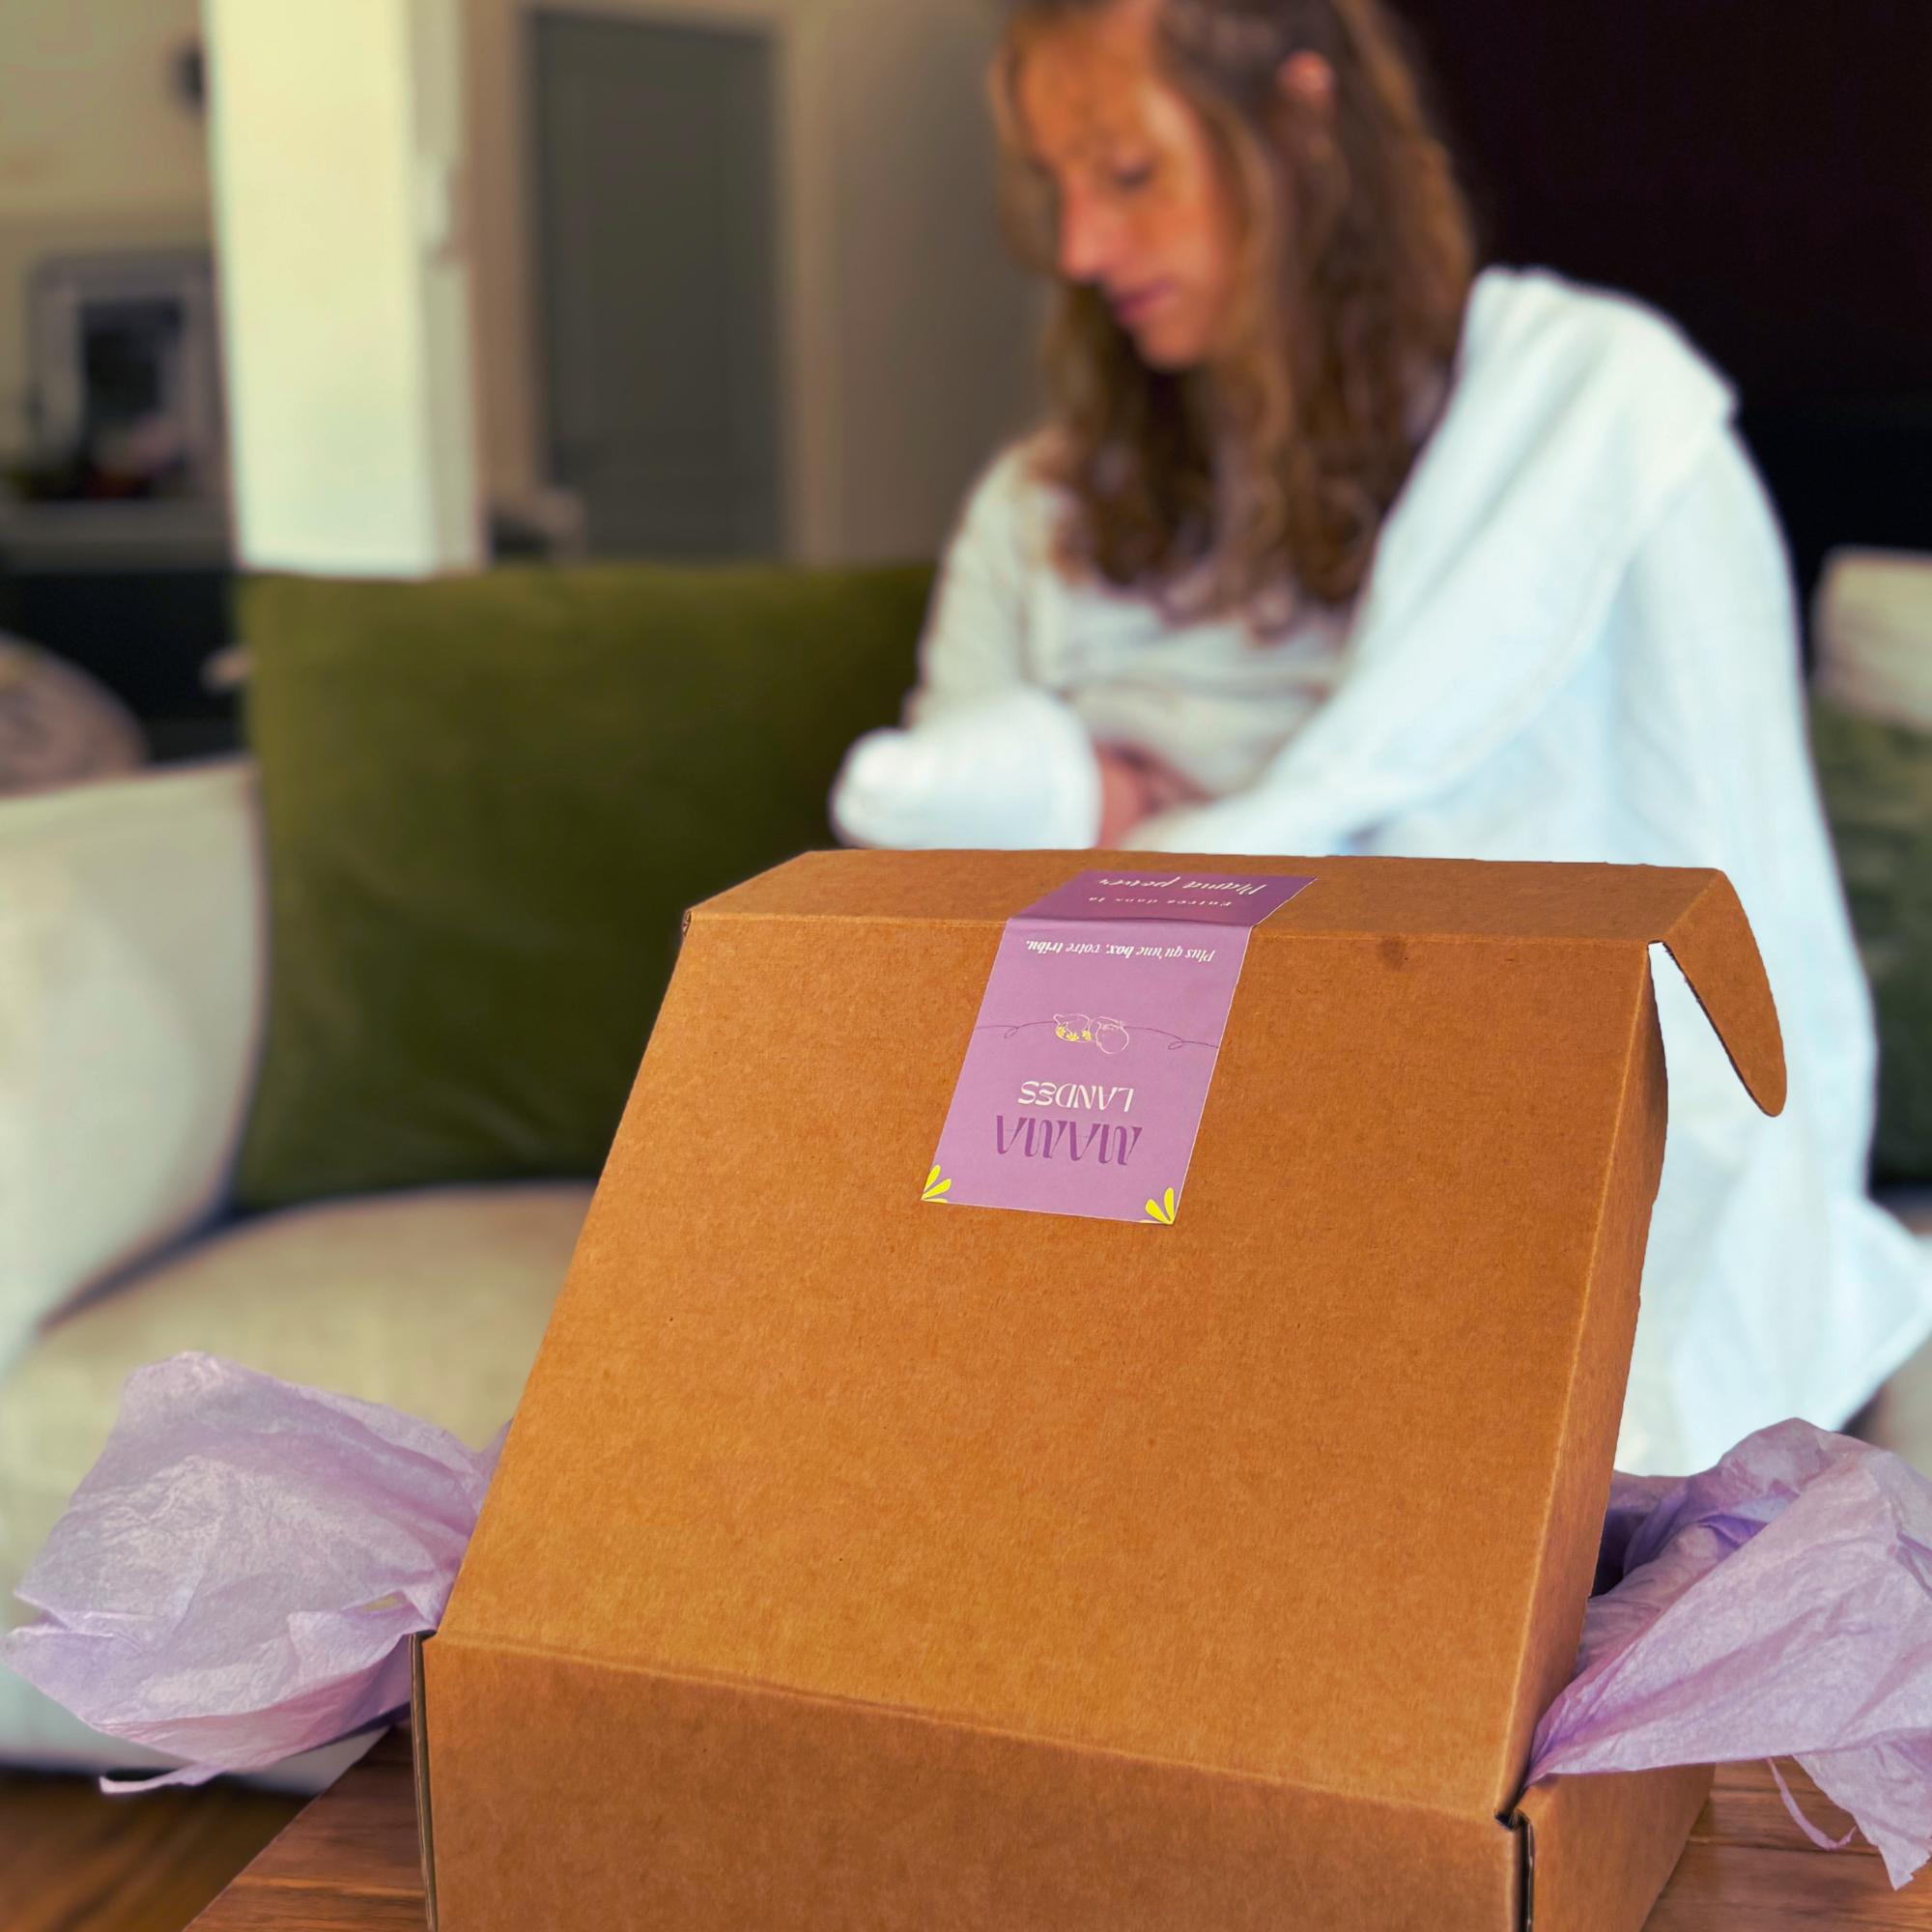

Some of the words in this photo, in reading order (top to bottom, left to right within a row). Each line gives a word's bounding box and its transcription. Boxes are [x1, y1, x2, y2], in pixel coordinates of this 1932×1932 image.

[1026, 940, 1064, 954] tribu.
[1065, 942, 1101, 955] votre
[1106, 943, 1135, 959] box,
[1184, 949, 1216, 963] Plus
[1017, 1080, 1134, 1112] LANDES
[996, 1115, 1143, 1166] MAMA
